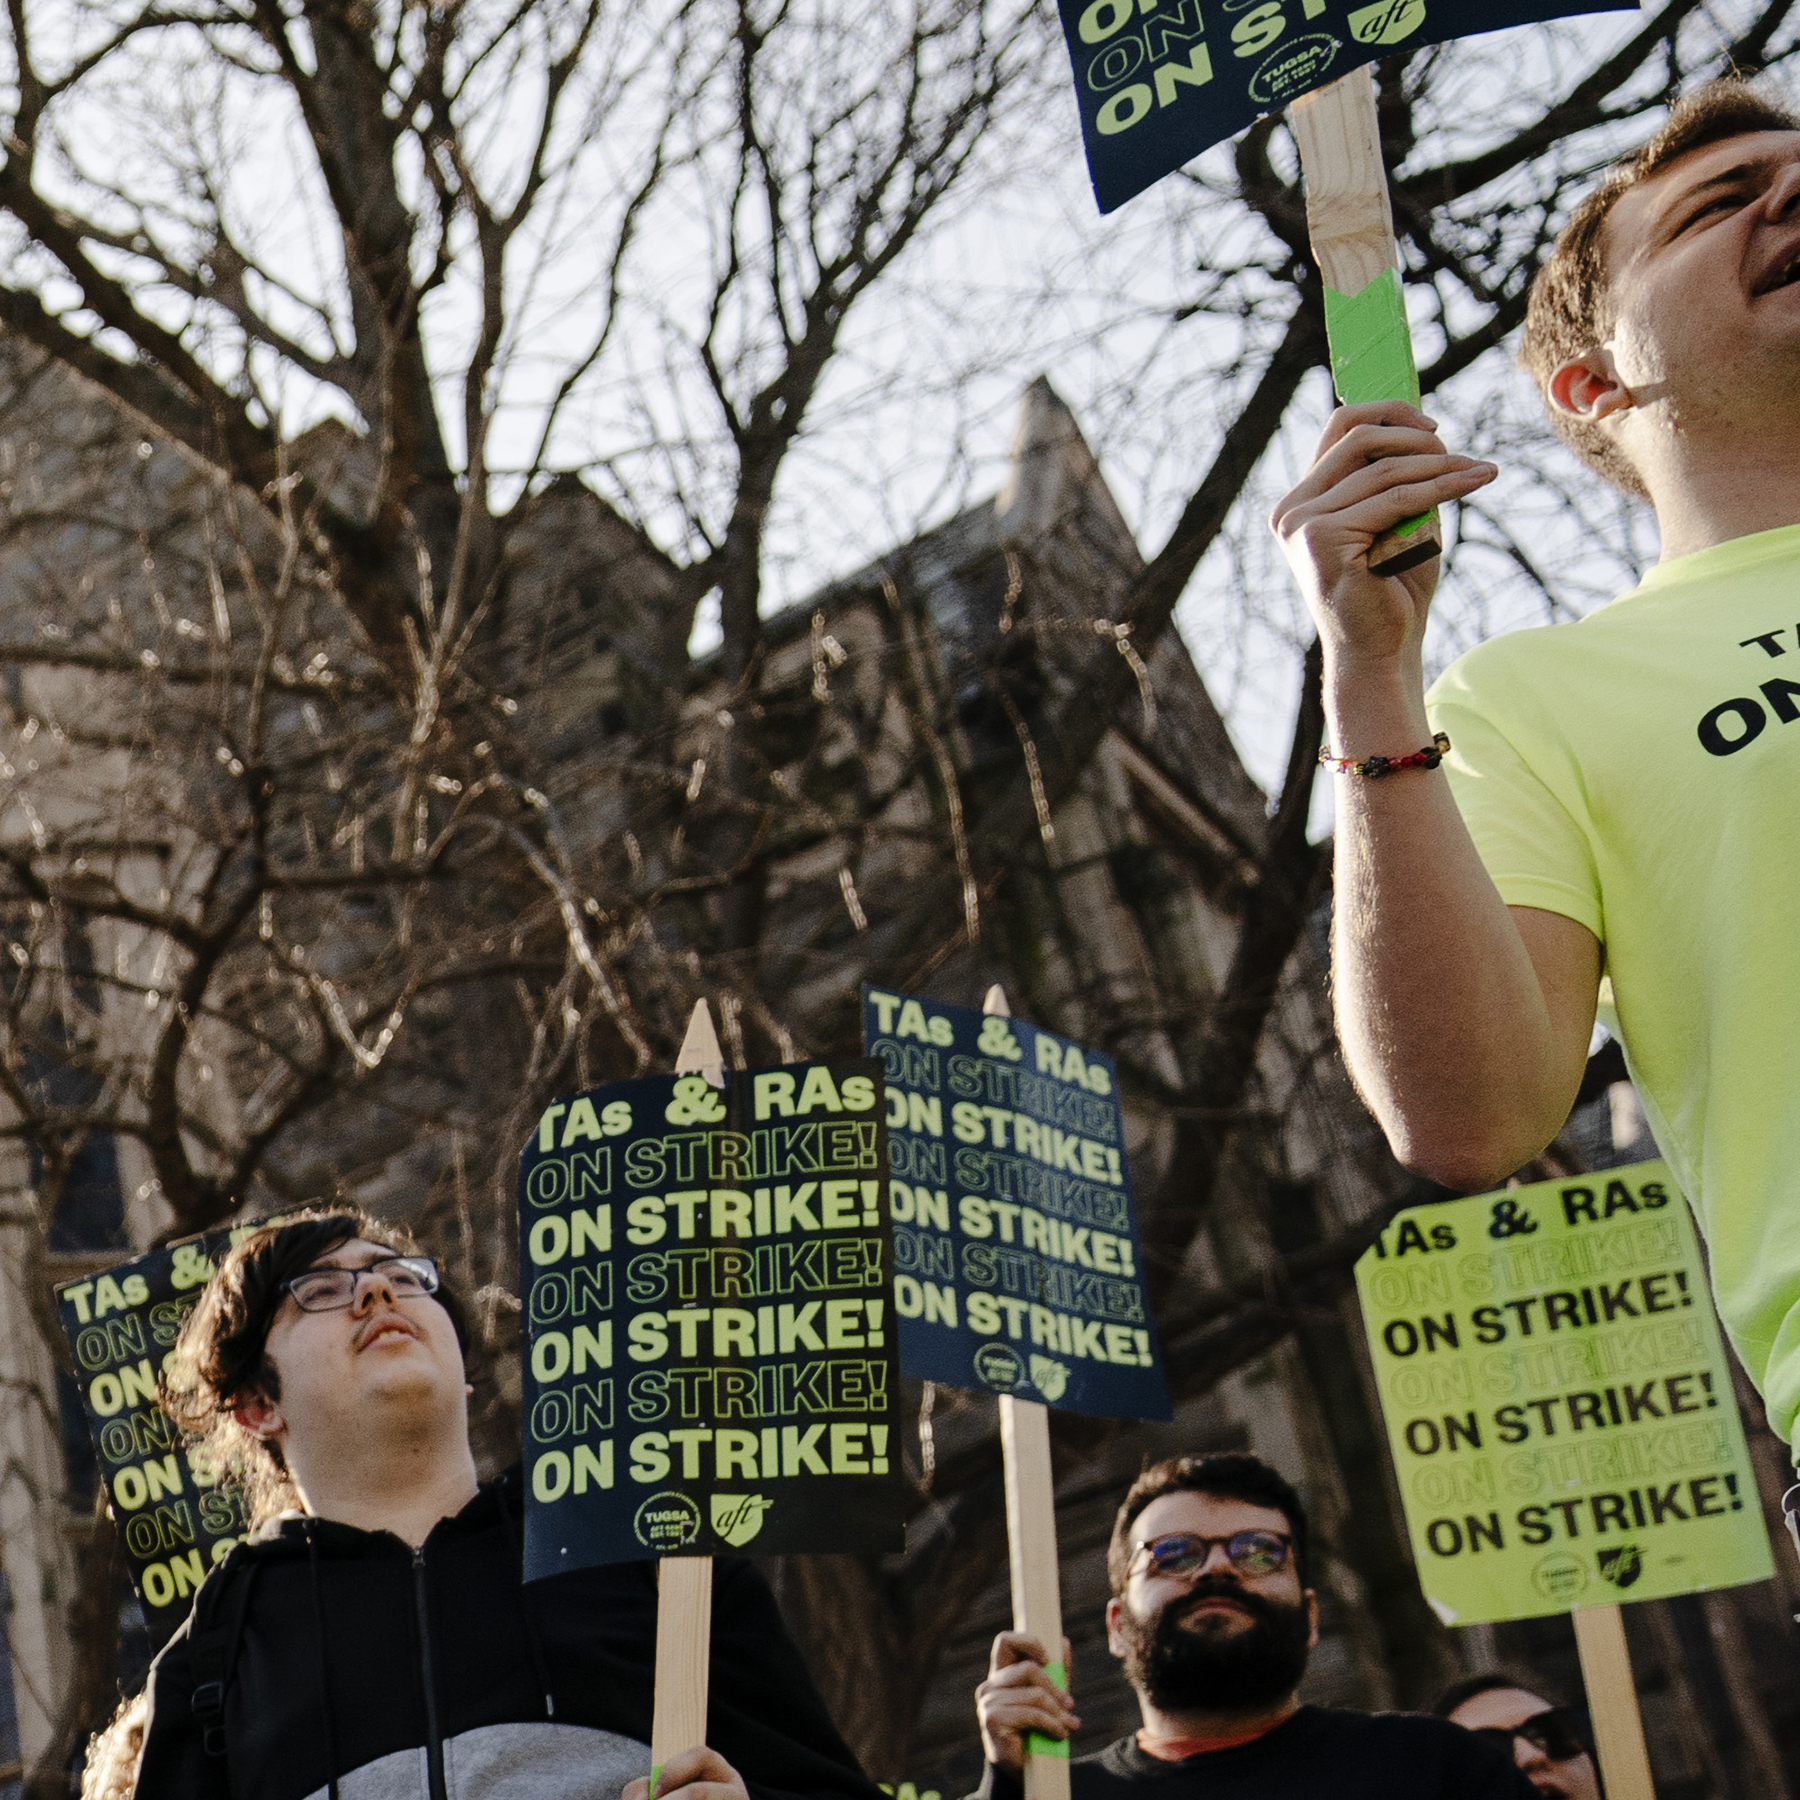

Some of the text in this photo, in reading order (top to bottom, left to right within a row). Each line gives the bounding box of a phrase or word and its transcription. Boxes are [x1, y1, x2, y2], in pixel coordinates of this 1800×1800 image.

[1088, 0, 1204, 91] ON
[1096, 41, 1213, 135] ON
[868, 990, 1112, 1096] TAs & RAs
[538, 1065, 876, 1153] TAs & RAs
[885, 1086, 1124, 1185] ON STRIKE!
[527, 1120, 877, 1208] ON STRIKE!
[529, 1179, 880, 1266] ON STRIKE!
[889, 1180, 1136, 1277] ON STRIKE!
[1488, 1199, 1540, 1241] &
[1561, 1179, 1671, 1227] RAs
[63, 1274, 149, 1325] TAs
[171, 1245, 217, 1290] &
[529, 1238, 883, 1324] ON STRIKE!
[894, 1273, 958, 1328] ON
[966, 1291, 1154, 1367] STRIKE!
[1383, 1271, 1693, 1358] ON STRIKE!
[76, 1313, 148, 1371] ON
[531, 1299, 885, 1383] ON STRIKE!
[89, 1358, 156, 1417] ON
[531, 1359, 888, 1443] ON STRIKE!
[1405, 1372, 1718, 1457] ON STRIKE!
[101, 1409, 171, 1464] ON
[532, 1422, 889, 1503] ON STRIKE!
[113, 1453, 184, 1511] ON
[644, 1510, 690, 1523] TUGSA
[1426, 1474, 1744, 1558] ON STRIKE!
[126, 1500, 195, 1559] ON
[142, 1548, 205, 1608] ON
